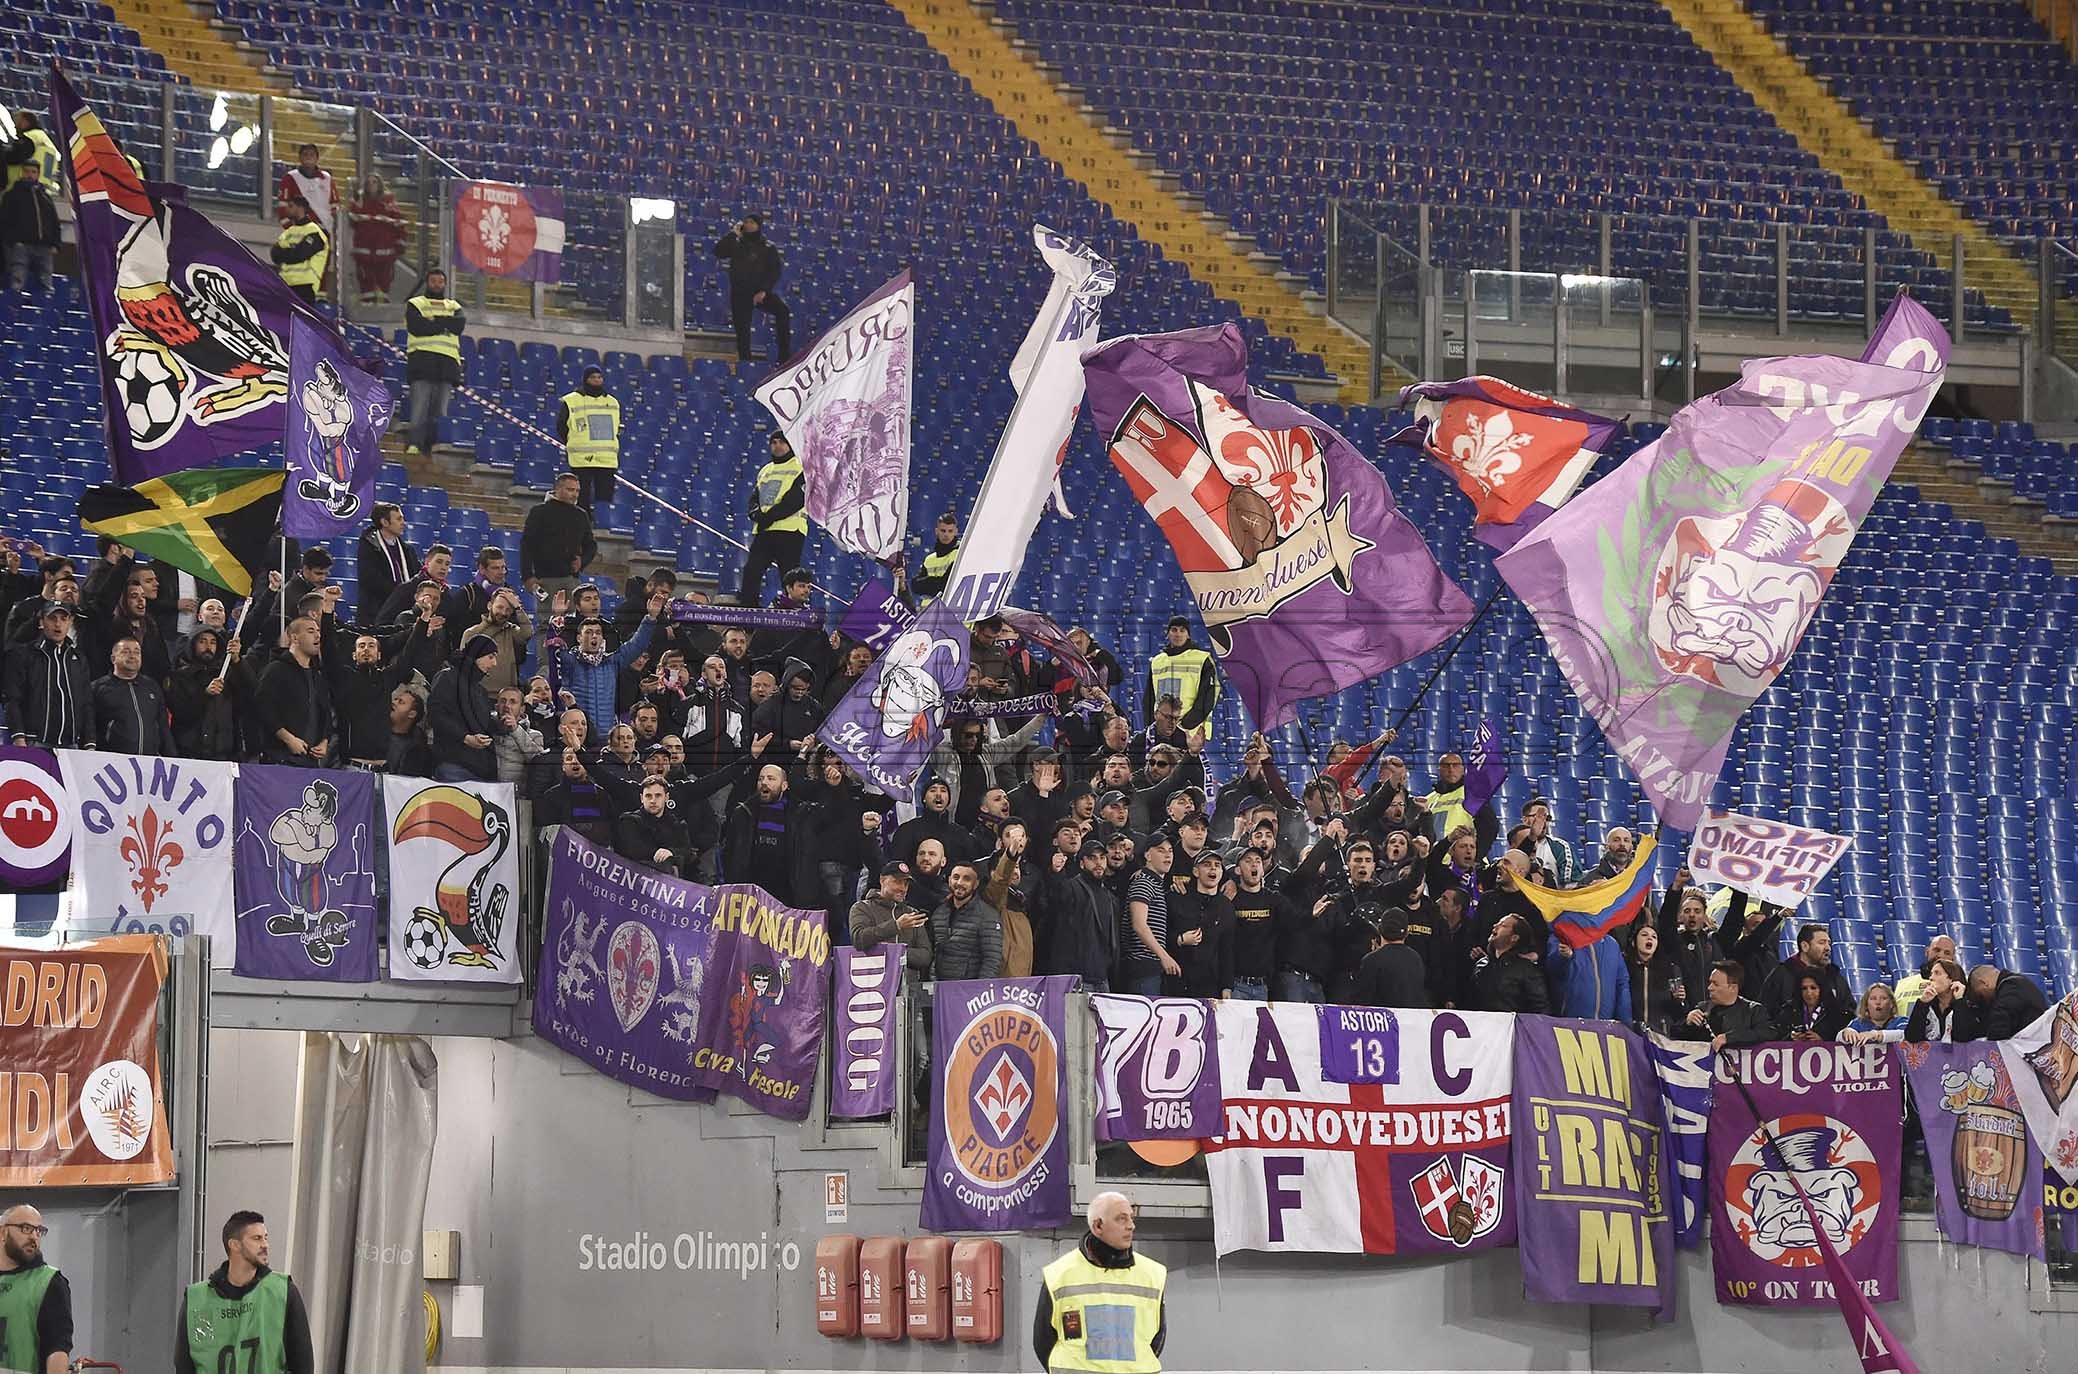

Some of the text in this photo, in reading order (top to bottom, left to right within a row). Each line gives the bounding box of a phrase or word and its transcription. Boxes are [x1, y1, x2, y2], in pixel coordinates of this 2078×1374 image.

[82, 757, 225, 849] QUINTO
[567, 840, 687, 911] FIORENTINA
[577, 872, 625, 906] August
[630, 898, 667, 925] 26th
[0, 960, 108, 1029] DRID
[966, 984, 1045, 1016] mai scesi
[1340, 1009, 1389, 1033] ASTORI
[846, 951, 887, 1093] DOCG
[967, 1016, 1041, 1057] GRUPPO
[1247, 1007, 1472, 1097] A C
[1351, 1038, 1385, 1077] 13
[1553, 1026, 1632, 1111] MI
[1713, 1042, 1889, 1095] CICLONE
[1831, 1080, 1891, 1093] VIOLA
[1143, 1101, 1193, 1130] 1965
[1209, 1102, 1512, 1146] NONOVEDUESEI
[959, 1129, 1042, 1178] PIAGGE
[955, 1159, 1050, 1217] compromessi
[1263, 1156, 1305, 1242] F
[579, 1231, 801, 1281] Stadio Olimpio
[1578, 1209, 1658, 1287] MI
[1764, 1280, 1800, 1300] ON
